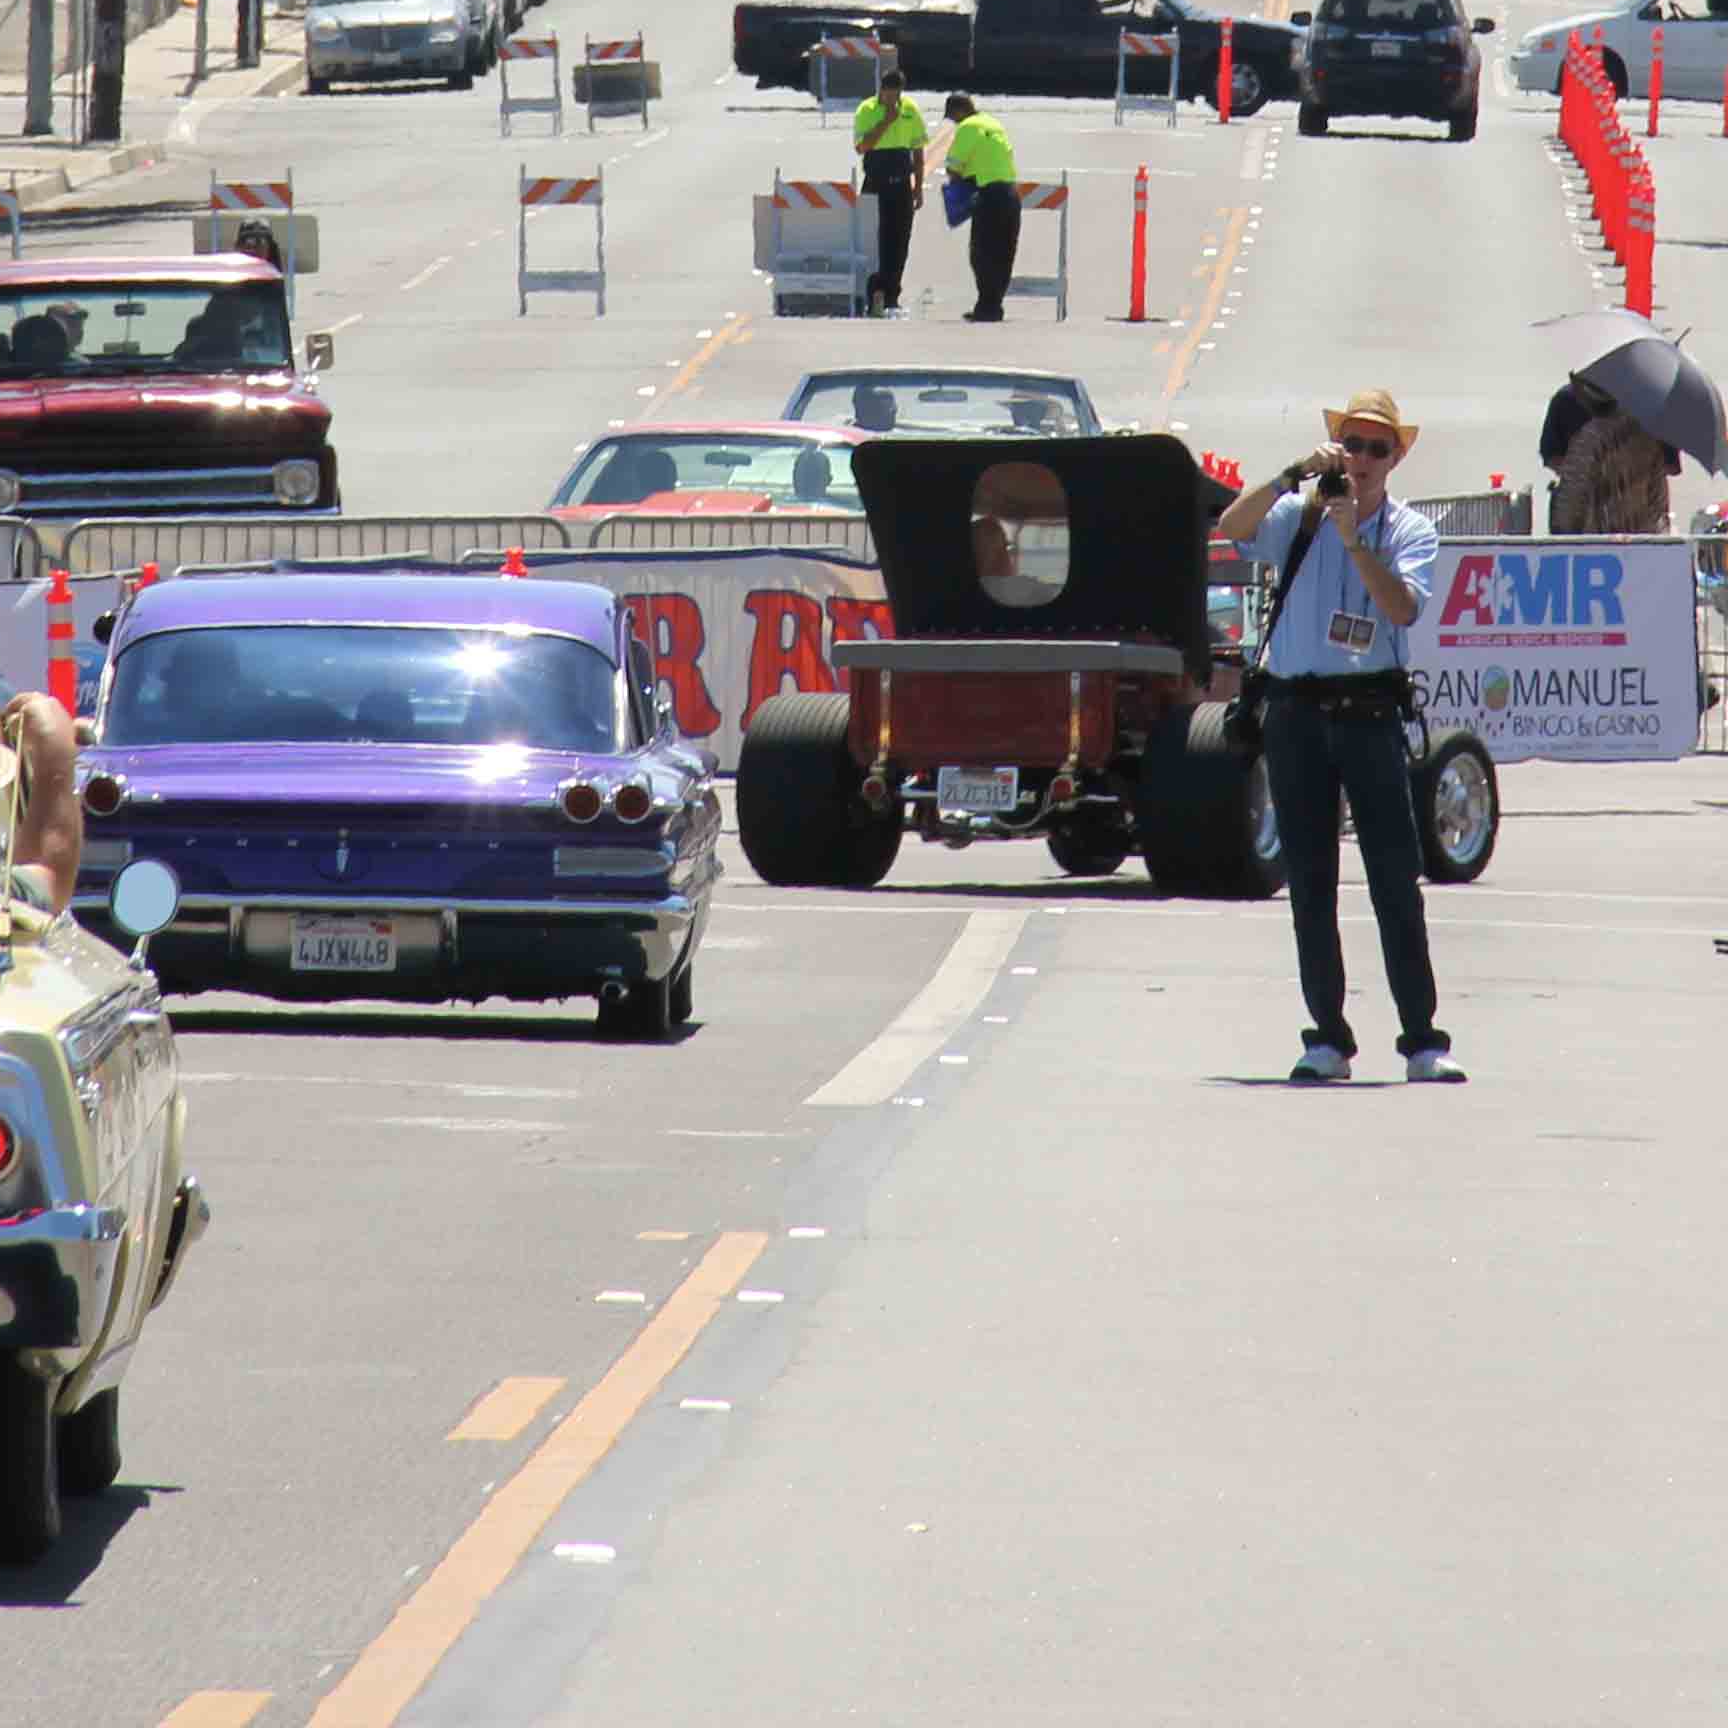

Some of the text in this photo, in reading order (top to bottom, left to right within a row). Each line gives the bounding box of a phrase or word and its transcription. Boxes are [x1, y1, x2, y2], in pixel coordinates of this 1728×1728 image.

[1439, 554, 1624, 625] AMR
[1411, 667, 1660, 708] SAN MANUEL
[1513, 715, 1571, 737] BINGO
[1595, 714, 1661, 737] CASINO
